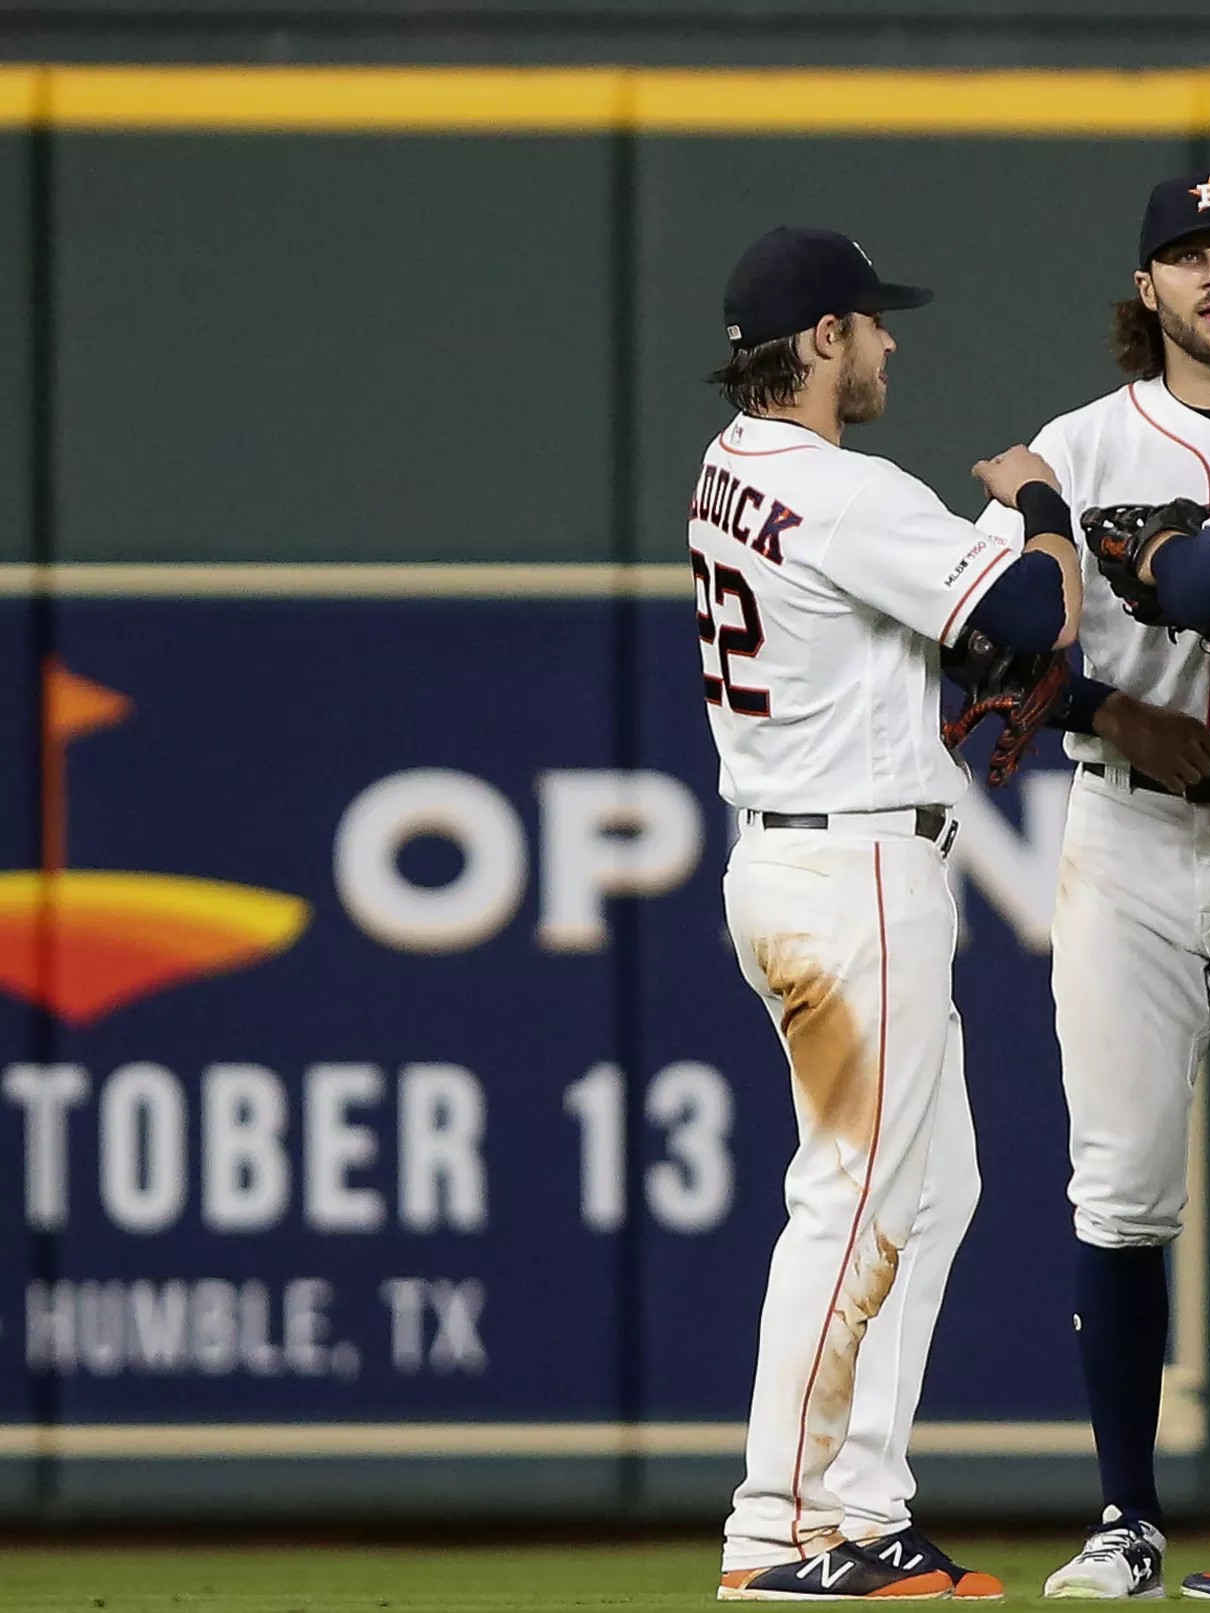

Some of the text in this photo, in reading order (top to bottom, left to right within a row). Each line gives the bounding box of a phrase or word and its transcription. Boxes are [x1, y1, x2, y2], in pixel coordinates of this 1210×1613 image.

[334, 767, 1078, 956] OPN
[3, 1060, 735, 1234] TOBER 13
[25, 1278, 487, 1381] HUMBLE, TX
[796, 1551, 854, 1589] N
